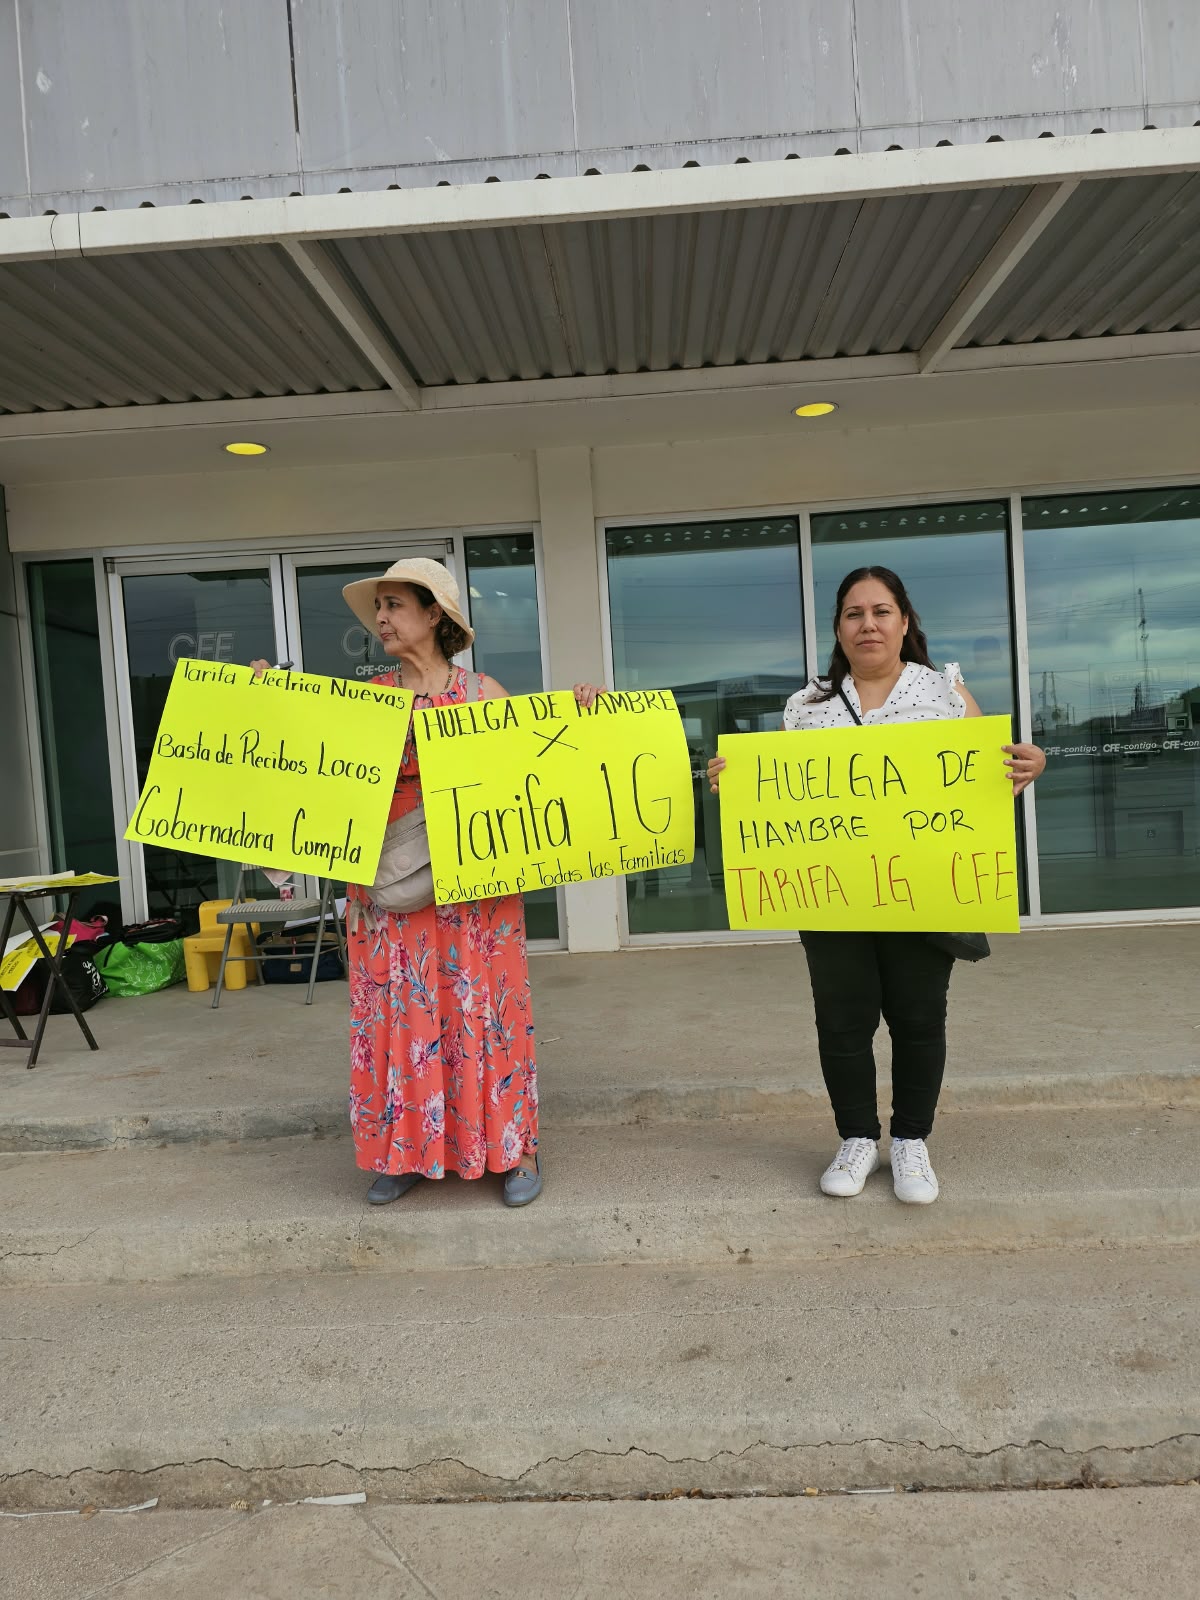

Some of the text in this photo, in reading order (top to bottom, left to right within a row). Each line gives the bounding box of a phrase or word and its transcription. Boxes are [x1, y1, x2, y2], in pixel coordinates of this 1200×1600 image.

[180, 660, 236, 686] Tarifa
[330, 679, 406, 710] Nuevas
[422, 699, 519, 742] HUELGA
[528, 693, 562, 721] DE
[157, 731, 210, 761] Basta
[215, 733, 234, 765] de
[240, 728, 308, 775] Recibos
[1102, 741, 1157, 753] CFE-contigo
[757, 749, 981, 802] HUELGA DE
[134, 785, 361, 871] Gobernadora Cumpla
[430, 773, 572, 866] Tarifa
[739, 808, 975, 854] HAMBRE POR
[436, 866, 510, 904] Solución
[531, 857, 583, 886] Todas
[588, 850, 615, 877] las
[617, 838, 687, 871] Familias
[727, 851, 1014, 923] TARIFA 1G CFE
